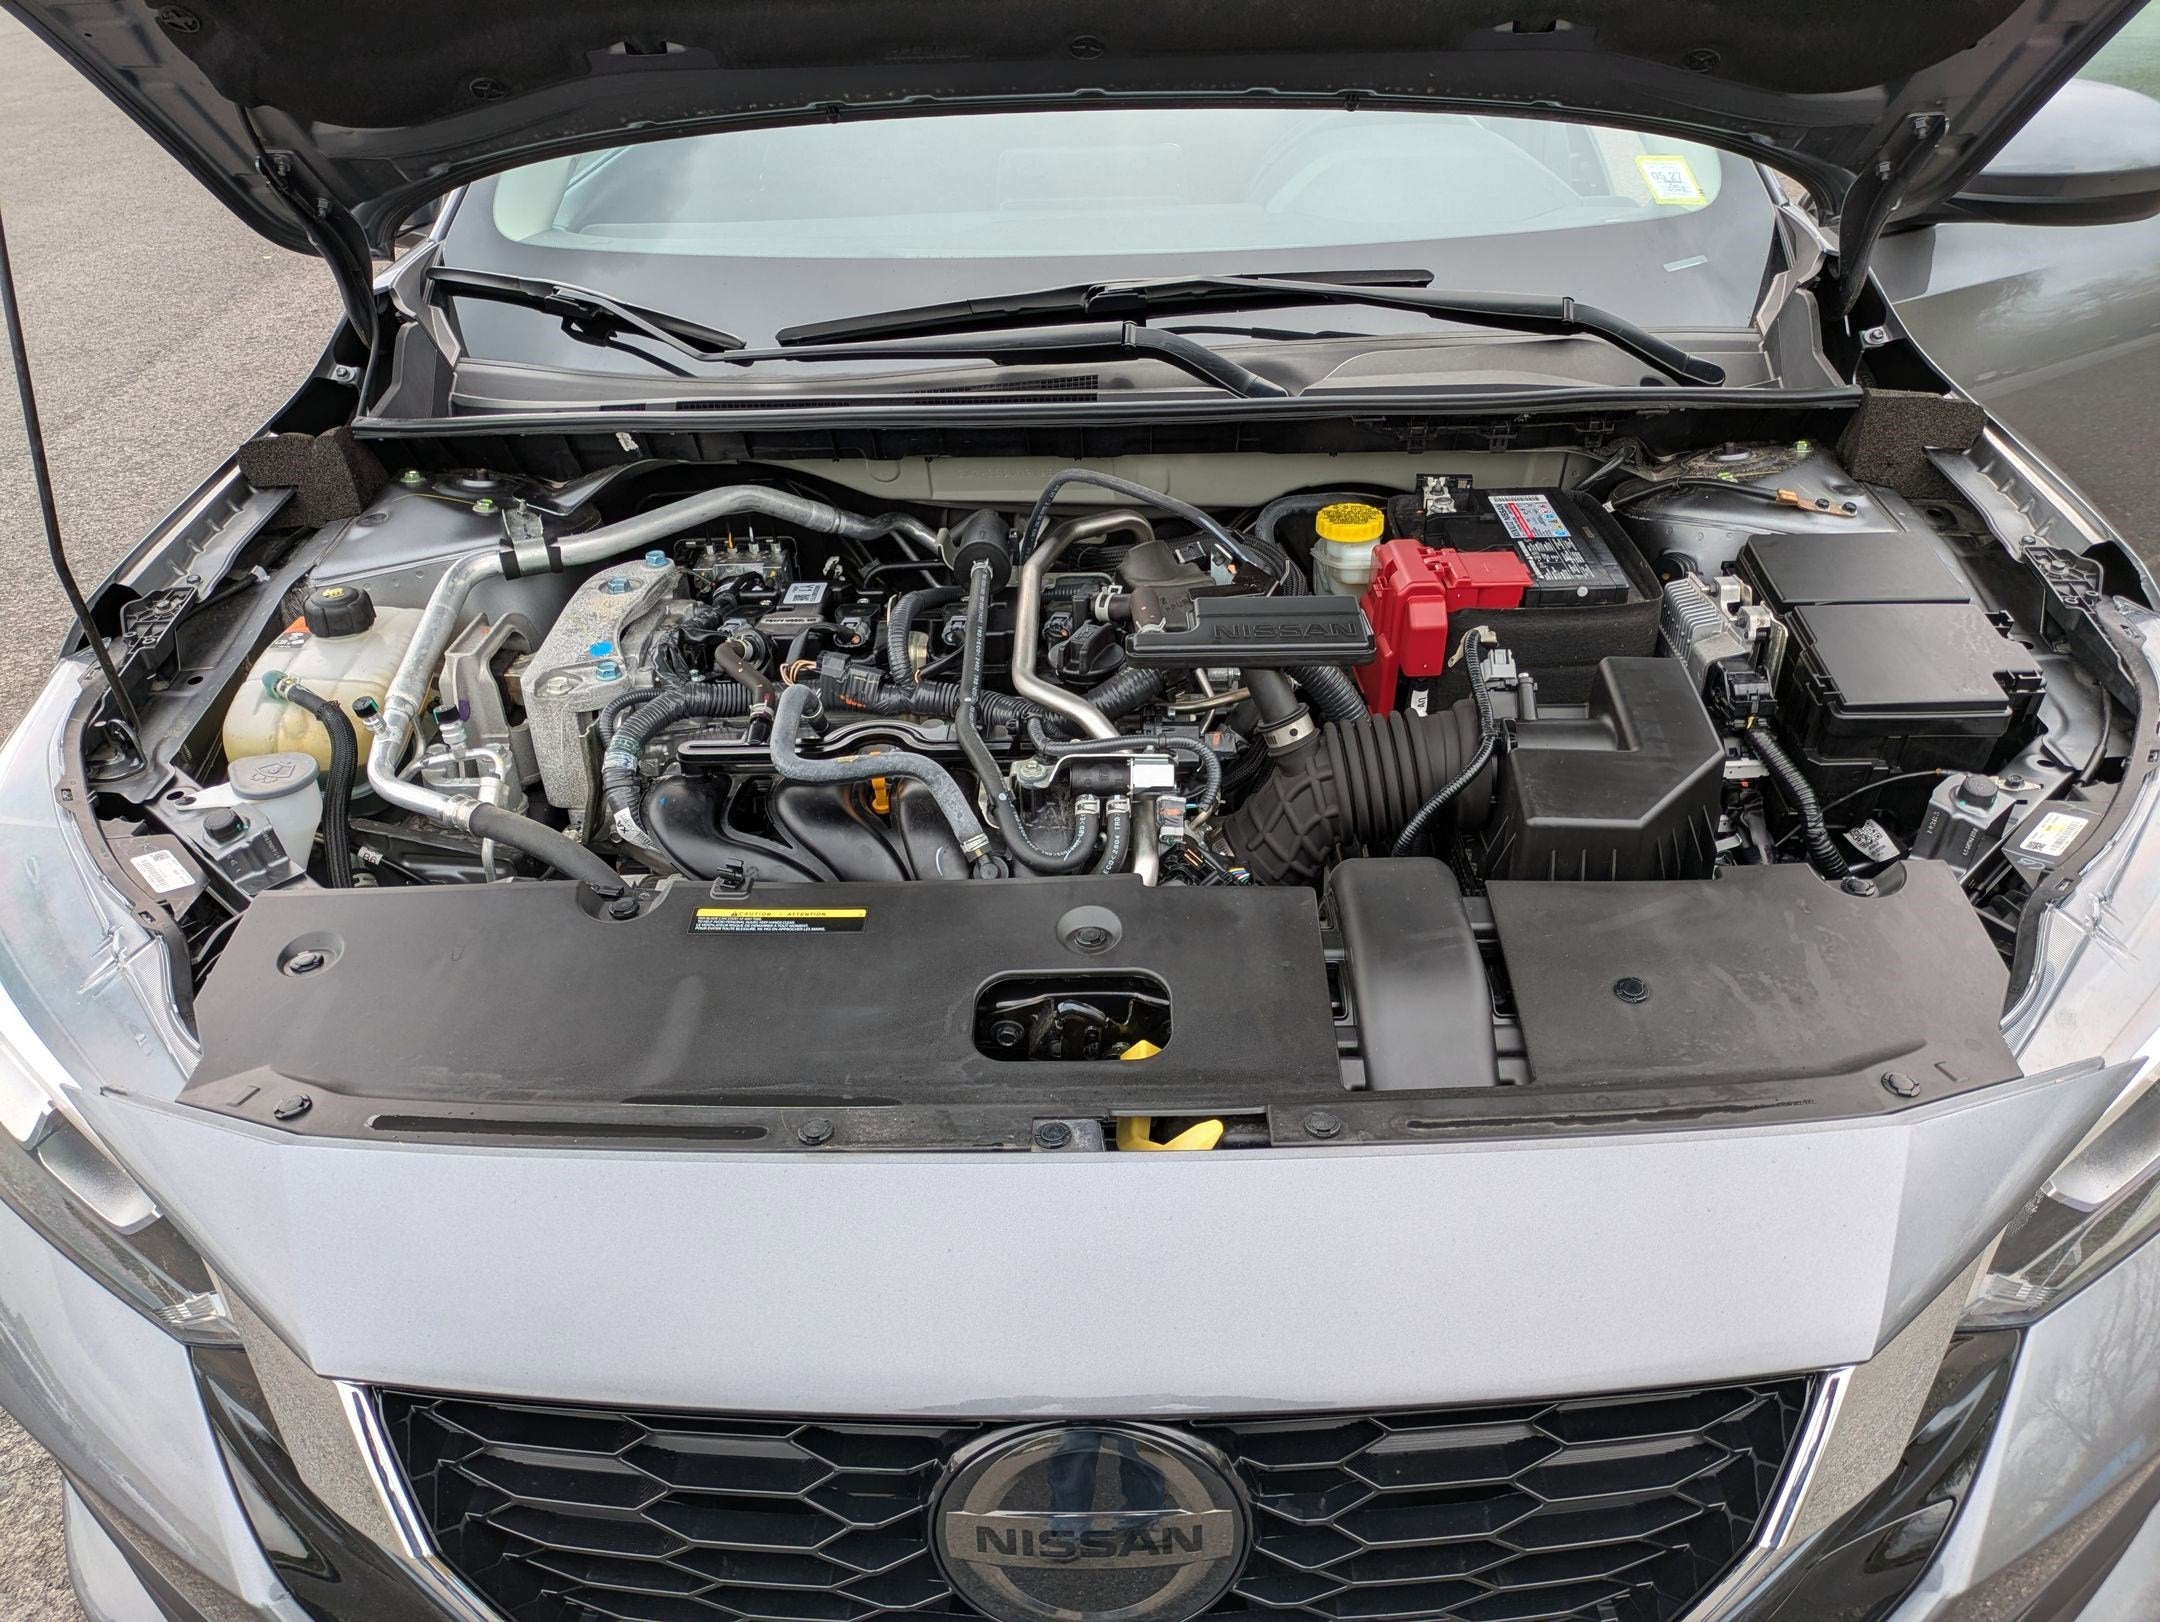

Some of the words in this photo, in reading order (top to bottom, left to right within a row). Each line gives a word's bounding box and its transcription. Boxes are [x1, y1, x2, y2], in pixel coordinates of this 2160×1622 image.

[1651, 171, 1666, 180] 05
[1213, 623, 1357, 639] NISSAN
[975, 1524, 1203, 1563] NISSAN
